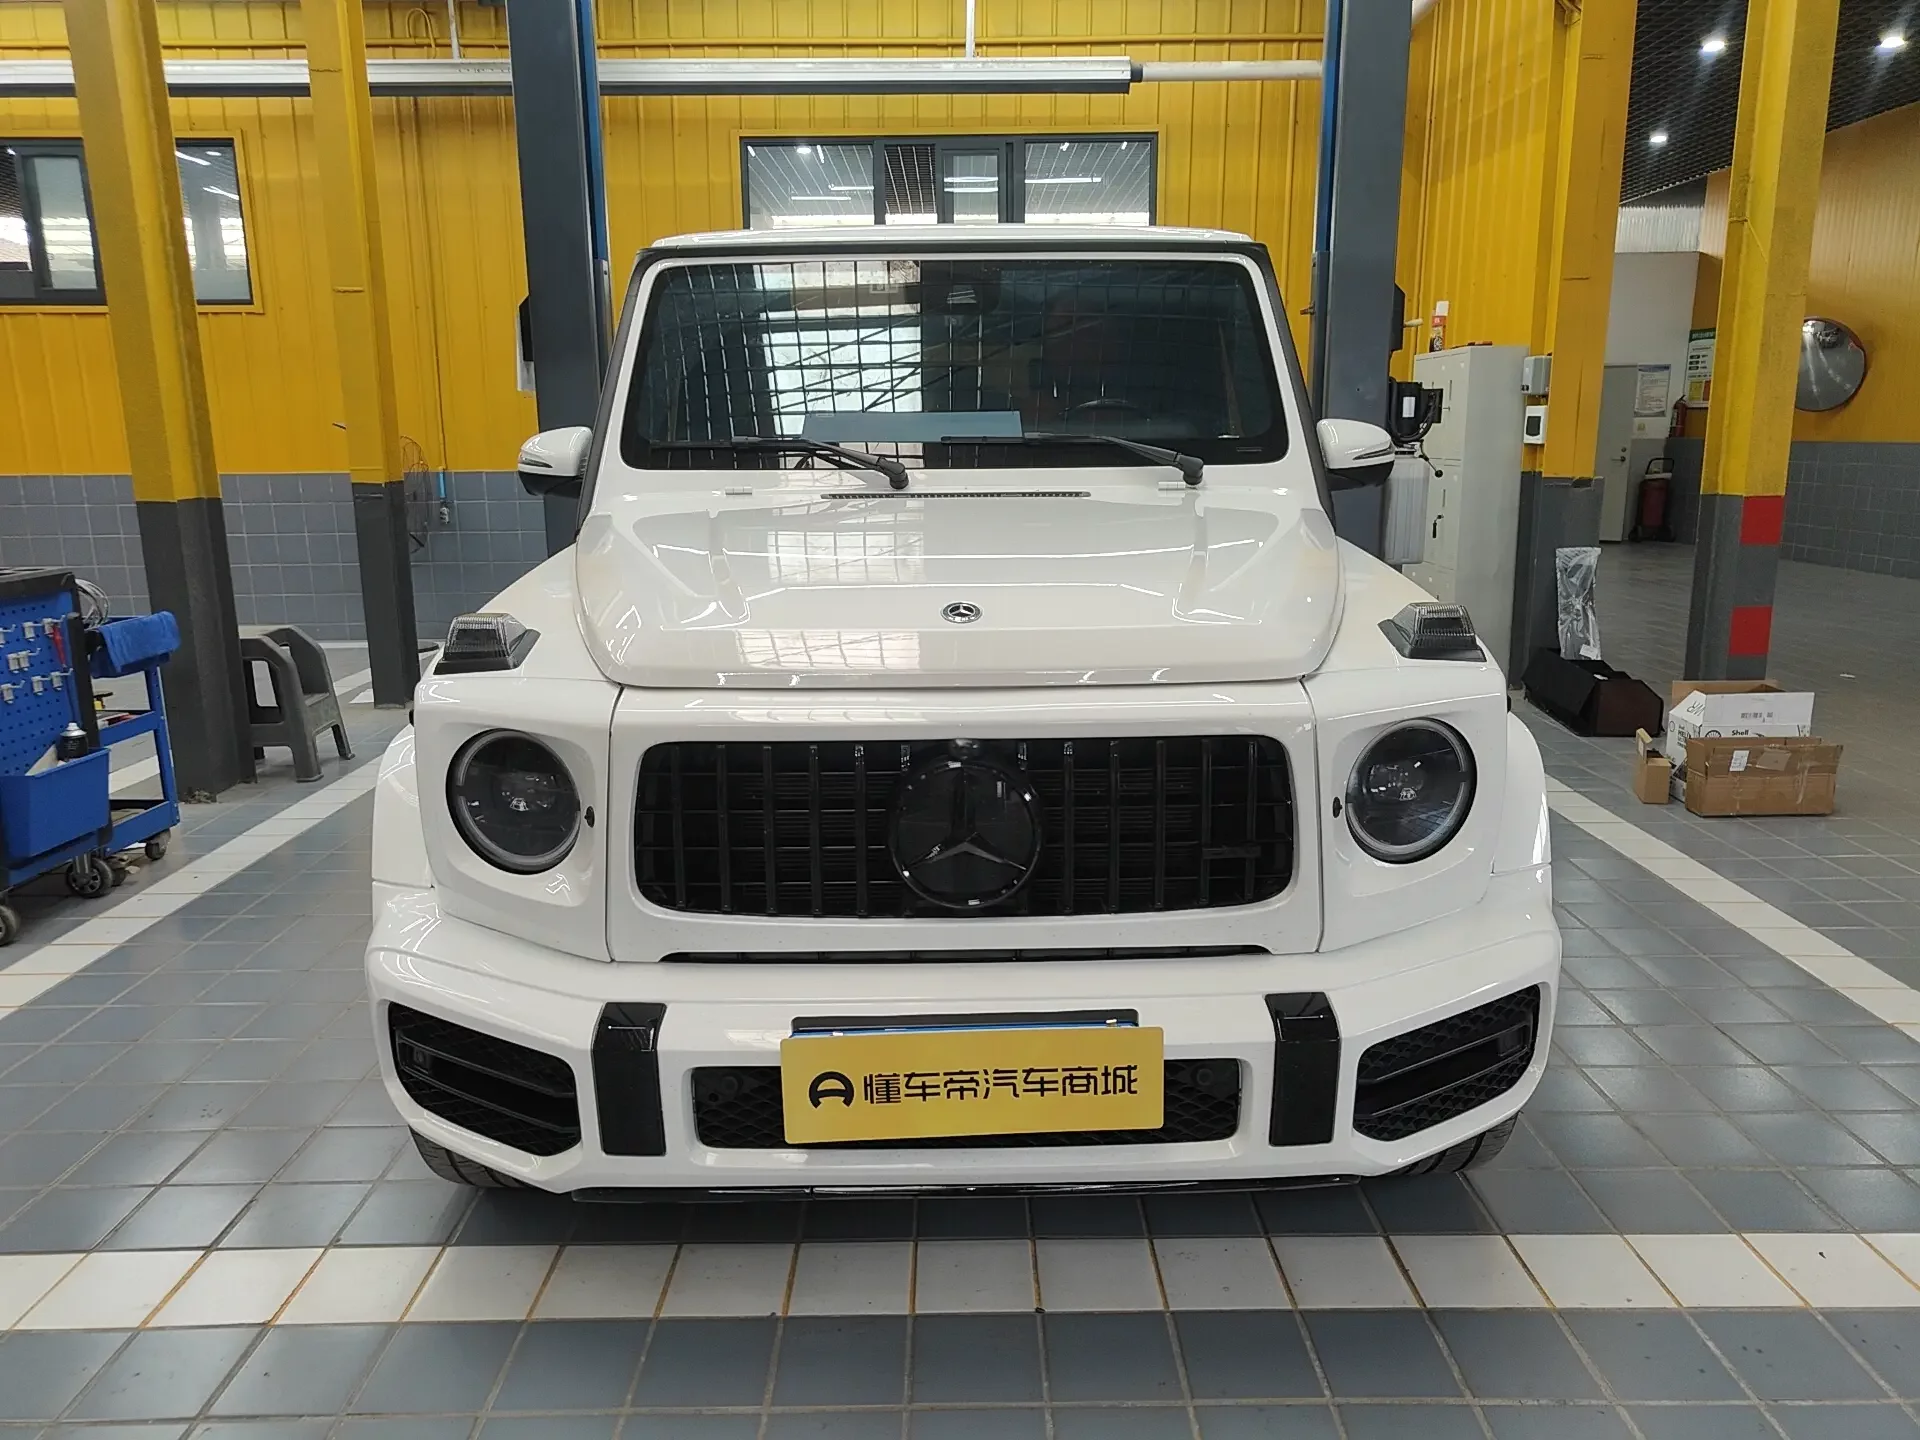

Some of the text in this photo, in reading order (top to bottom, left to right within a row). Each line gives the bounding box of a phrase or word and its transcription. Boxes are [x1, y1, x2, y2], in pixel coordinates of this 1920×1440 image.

[863, 1064, 1138, 1105] 懂车帝汽车商城
